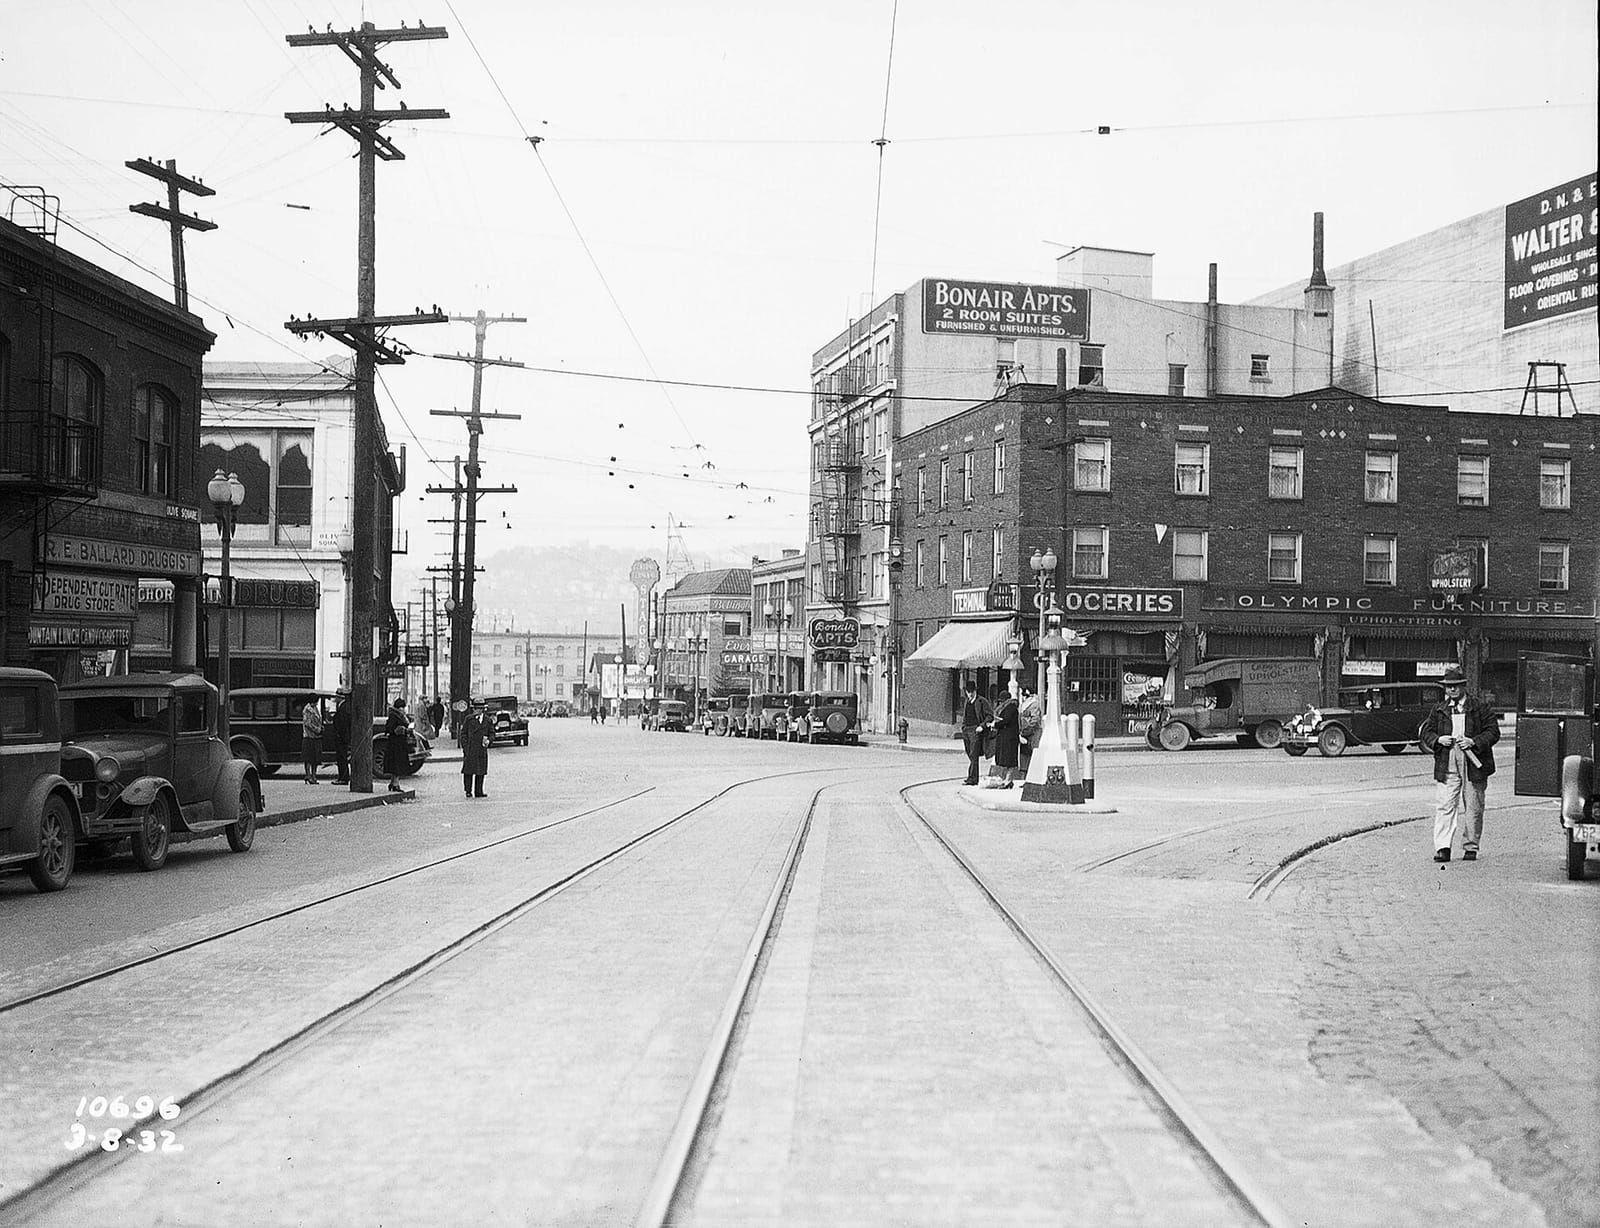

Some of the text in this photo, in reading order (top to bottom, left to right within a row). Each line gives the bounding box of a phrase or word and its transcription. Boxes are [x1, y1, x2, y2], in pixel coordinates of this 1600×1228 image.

[1541, 199, 1552, 214] D.
[1556, 193, 1569, 209] N.
[1573, 187, 1584, 203] &
[1511, 213, 1584, 261] WALTER
[1530, 246, 1597, 274] WHOLESALE SINCE
[1509, 281, 1534, 300] FLOOR
[1536, 268, 1579, 291] COVERINGS
[935, 281, 1077, 314] BONAIR APTS.
[1537, 289, 1578, 311] ORIENTAL
[935, 320, 986, 332] FURNISHED
[989, 324, 998, 332] &
[942, 307, 1062, 325] 2 ROOM SUITES
[181, 508, 199, 521] SQUARE
[80, 543, 135, 566] BALLARD
[140, 551, 193, 572] DRUGGIST
[238, 583, 315, 604] DRUGS
[1432, 578, 1472, 588] UPHOLSTERY
[54, 595, 115, 612] DRUG STORE
[99, 581, 115, 598] CUT
[116, 583, 136, 611] RATE
[954, 591, 987, 613] TERMINAL
[1238, 594, 1567, 614] OLYMPIC FURNITURE
[639, 584, 647, 663] STAGES
[1350, 615, 1462, 626] UPHOLSTERING
[58, 626, 80, 644] LUNCH
[724, 654, 765, 663] GARAGE
